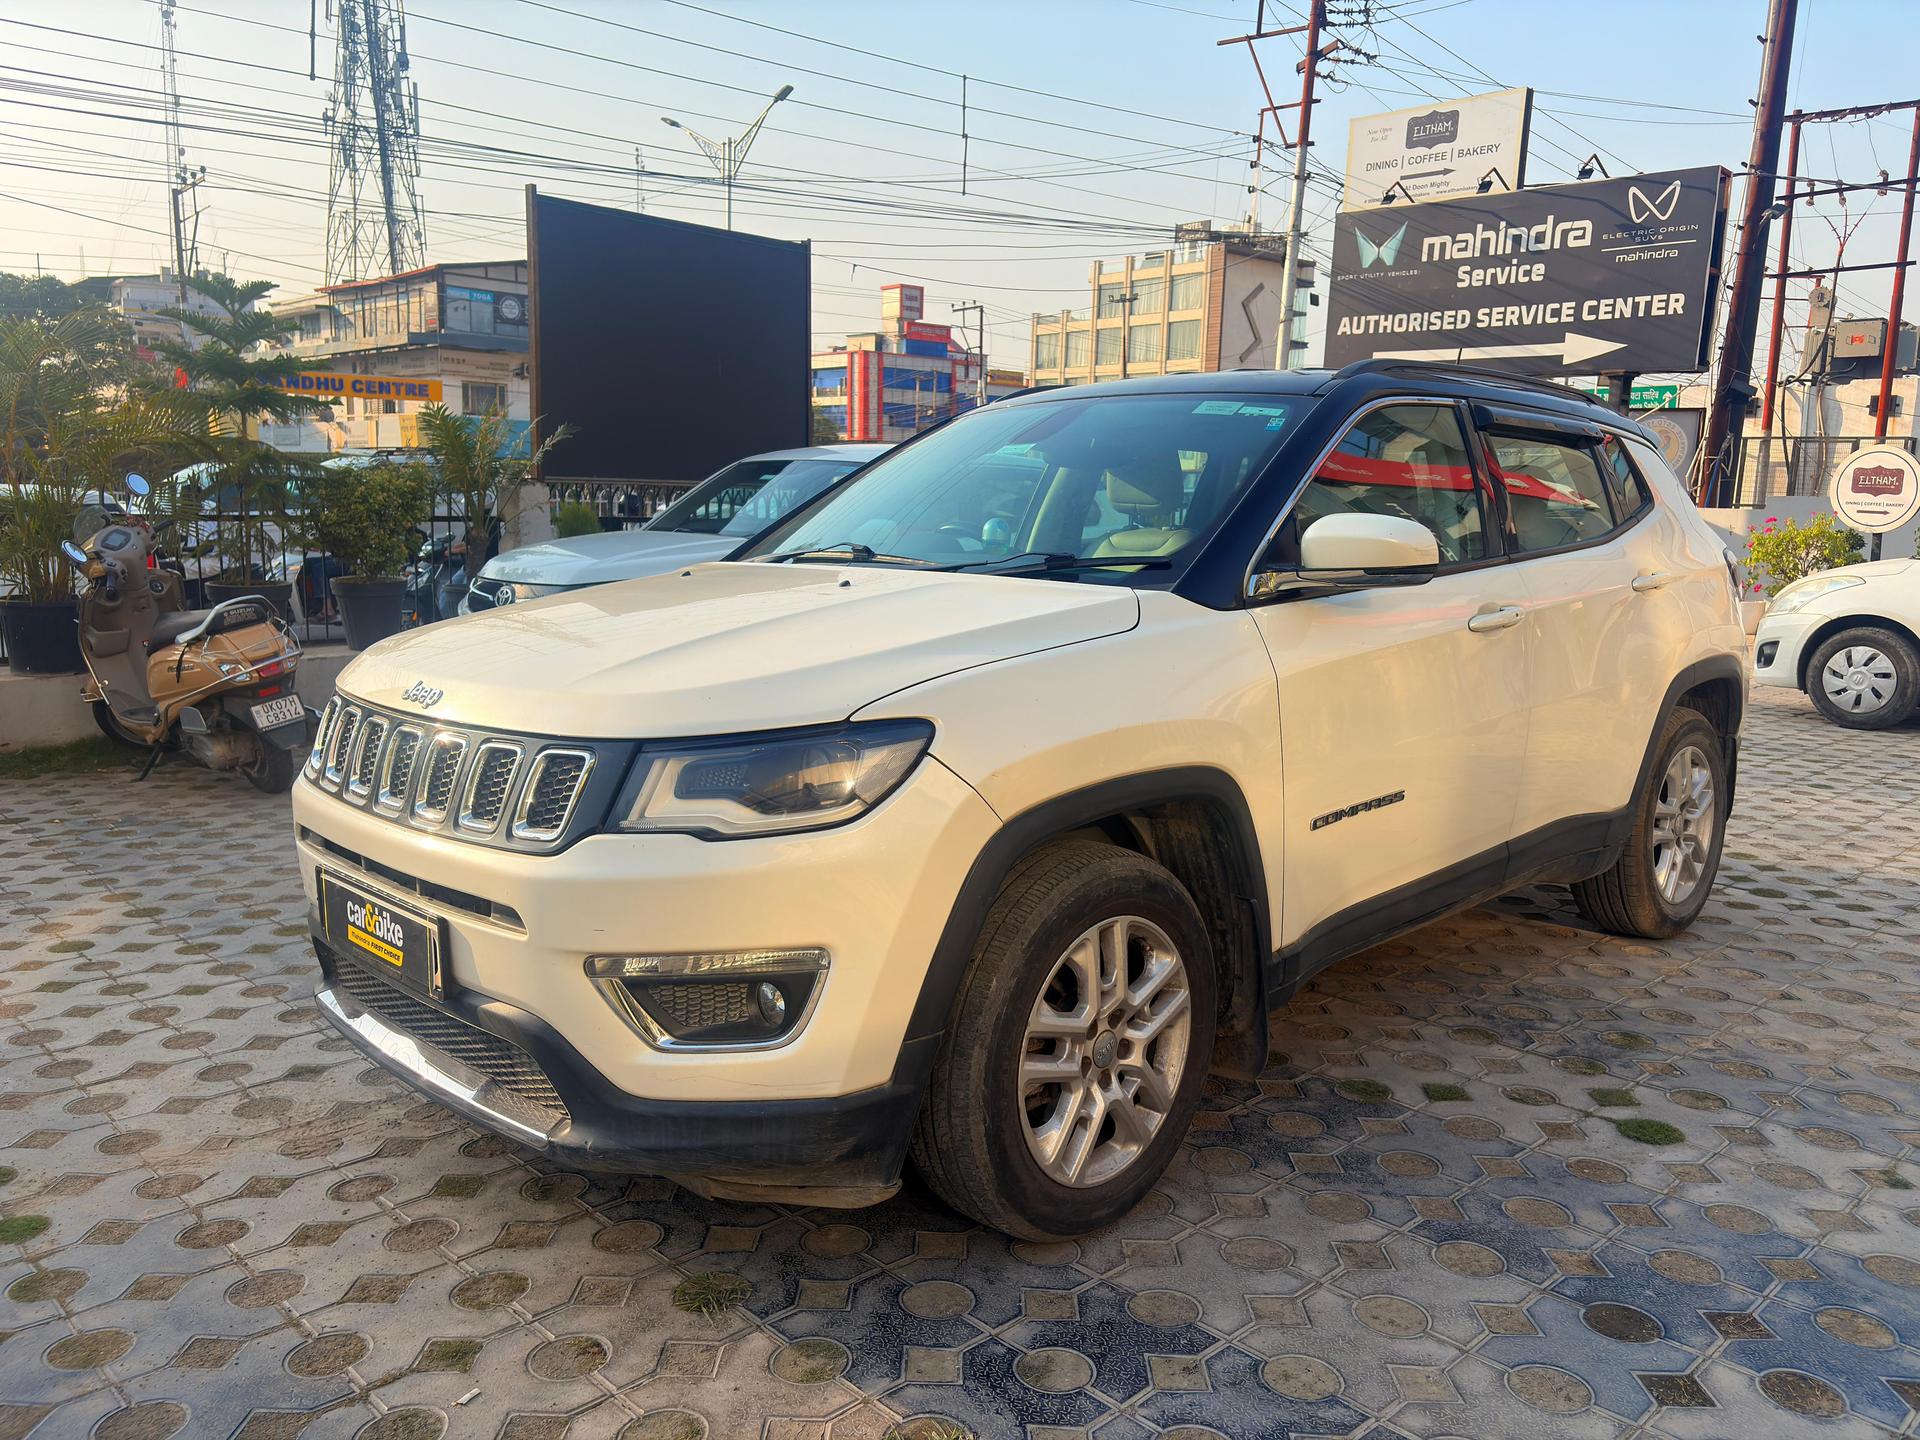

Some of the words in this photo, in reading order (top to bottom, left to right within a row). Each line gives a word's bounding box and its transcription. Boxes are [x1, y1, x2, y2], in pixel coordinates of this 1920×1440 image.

[1365, 158, 1399, 172] DINING
[1407, 151, 1448, 166] COFFEE
[1457, 143, 1501, 159] BAKERY
[1412, 183, 1429, 191] Doon
[1421, 214, 1593, 262] mahindra
[1602, 228, 1655, 240] ELECTRIC
[1660, 224, 1699, 233] ORIGIN
[1615, 248, 1679, 263] mahindra
[1337, 273, 1358, 281] SPORT
[1359, 272, 1385, 280] UTILITY
[1456, 258, 1546, 288] Service
[1336, 309, 1471, 336] AUTHORISED
[1476, 301, 1576, 328] SERVICE
[1581, 292, 1686, 321] CENTER
[351, 379, 430, 398] CENTRE
[401, 680, 444, 709] Jeep
[261, 697, 297, 714] UK07H
[266, 706, 301, 724] C8314
[1309, 789, 1406, 832] COMPASS
[346, 900, 404, 948] car&bike
[370, 941, 384, 953] FIRST
[383, 948, 401, 962] CHOICE
